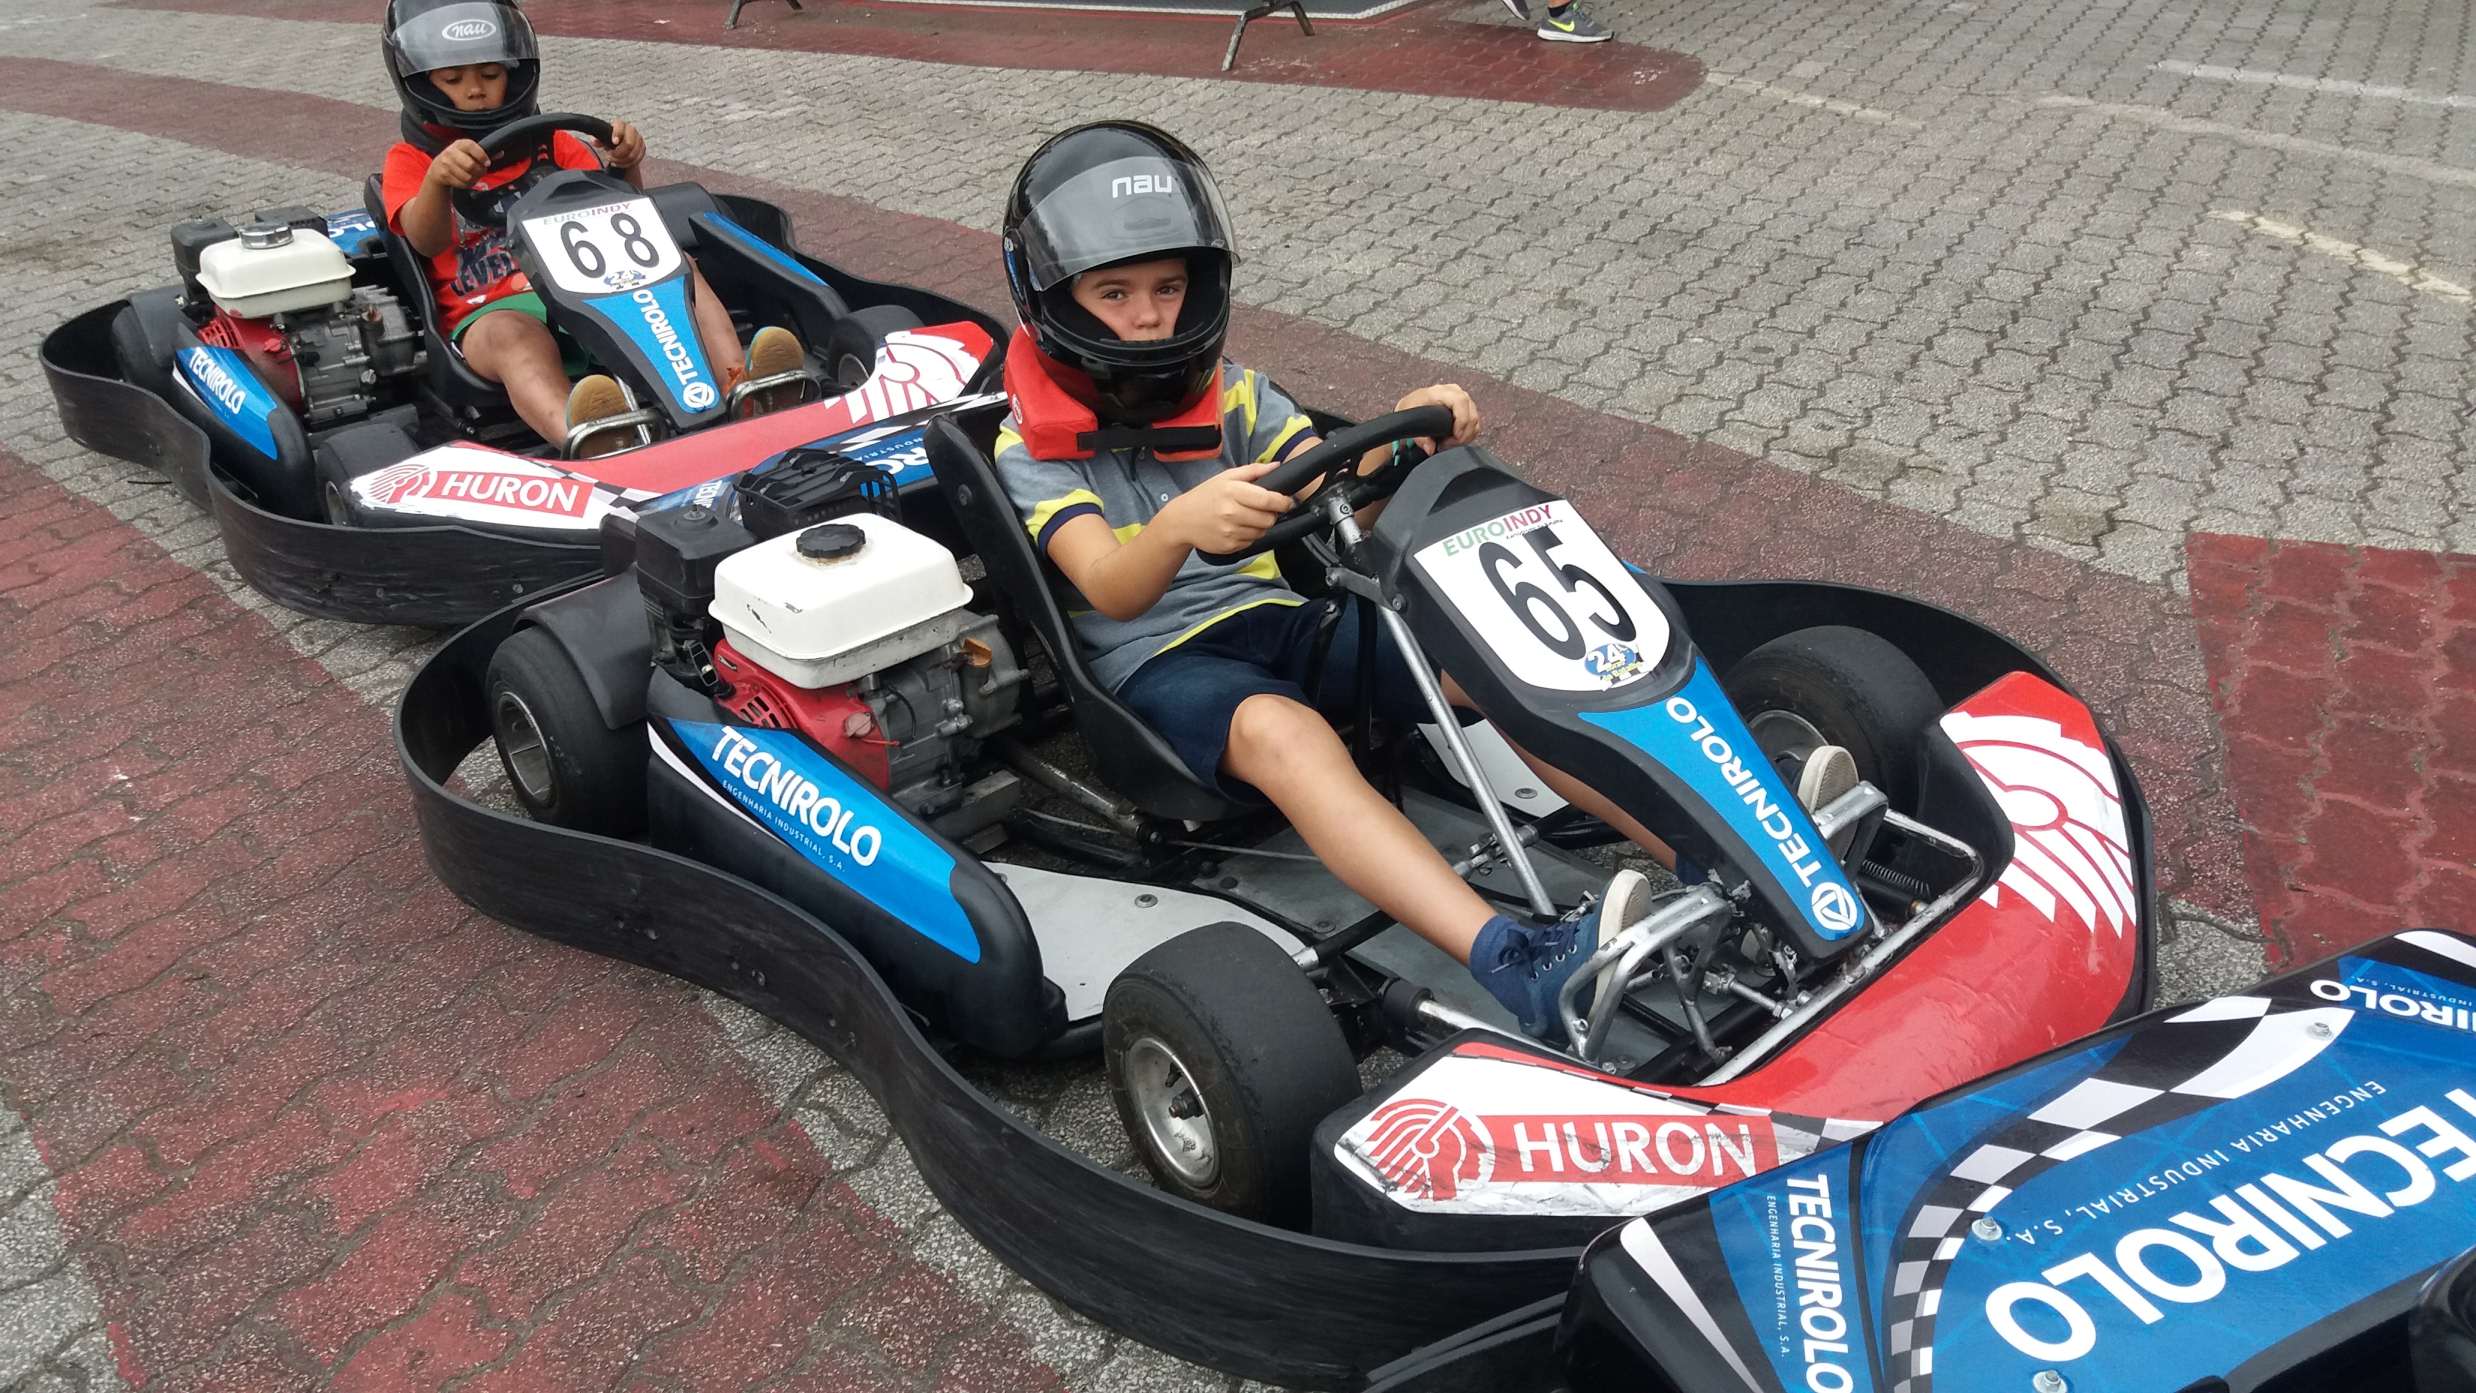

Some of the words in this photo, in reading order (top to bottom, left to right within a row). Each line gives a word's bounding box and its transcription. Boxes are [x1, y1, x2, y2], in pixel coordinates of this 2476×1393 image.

[452, 22, 487, 38] nau
[1112, 174, 1172, 199] nau
[560, 212, 660, 279] 68
[632, 289, 699, 386] TECNIROLO
[189, 346, 247, 415] TECNIROLO
[441, 473, 580, 512] HURON
[1442, 504, 1552, 557] EUROINDY
[1478, 525, 1637, 661] 65
[712, 725, 882, 867] TECNIROLO
[723, 779, 772, 820] ENGENHARIA
[1665, 697, 1822, 889] TECNIROLO
[2310, 979, 2476, 1033] IROLO
[1512, 1121, 1759, 1178] HURON
[2230, 1080, 2387, 1154] ENGENHARIA
[1766, 1195, 1781, 1260] ENGENHARIA
[1787, 1174, 1854, 1393] TECNIROLO
